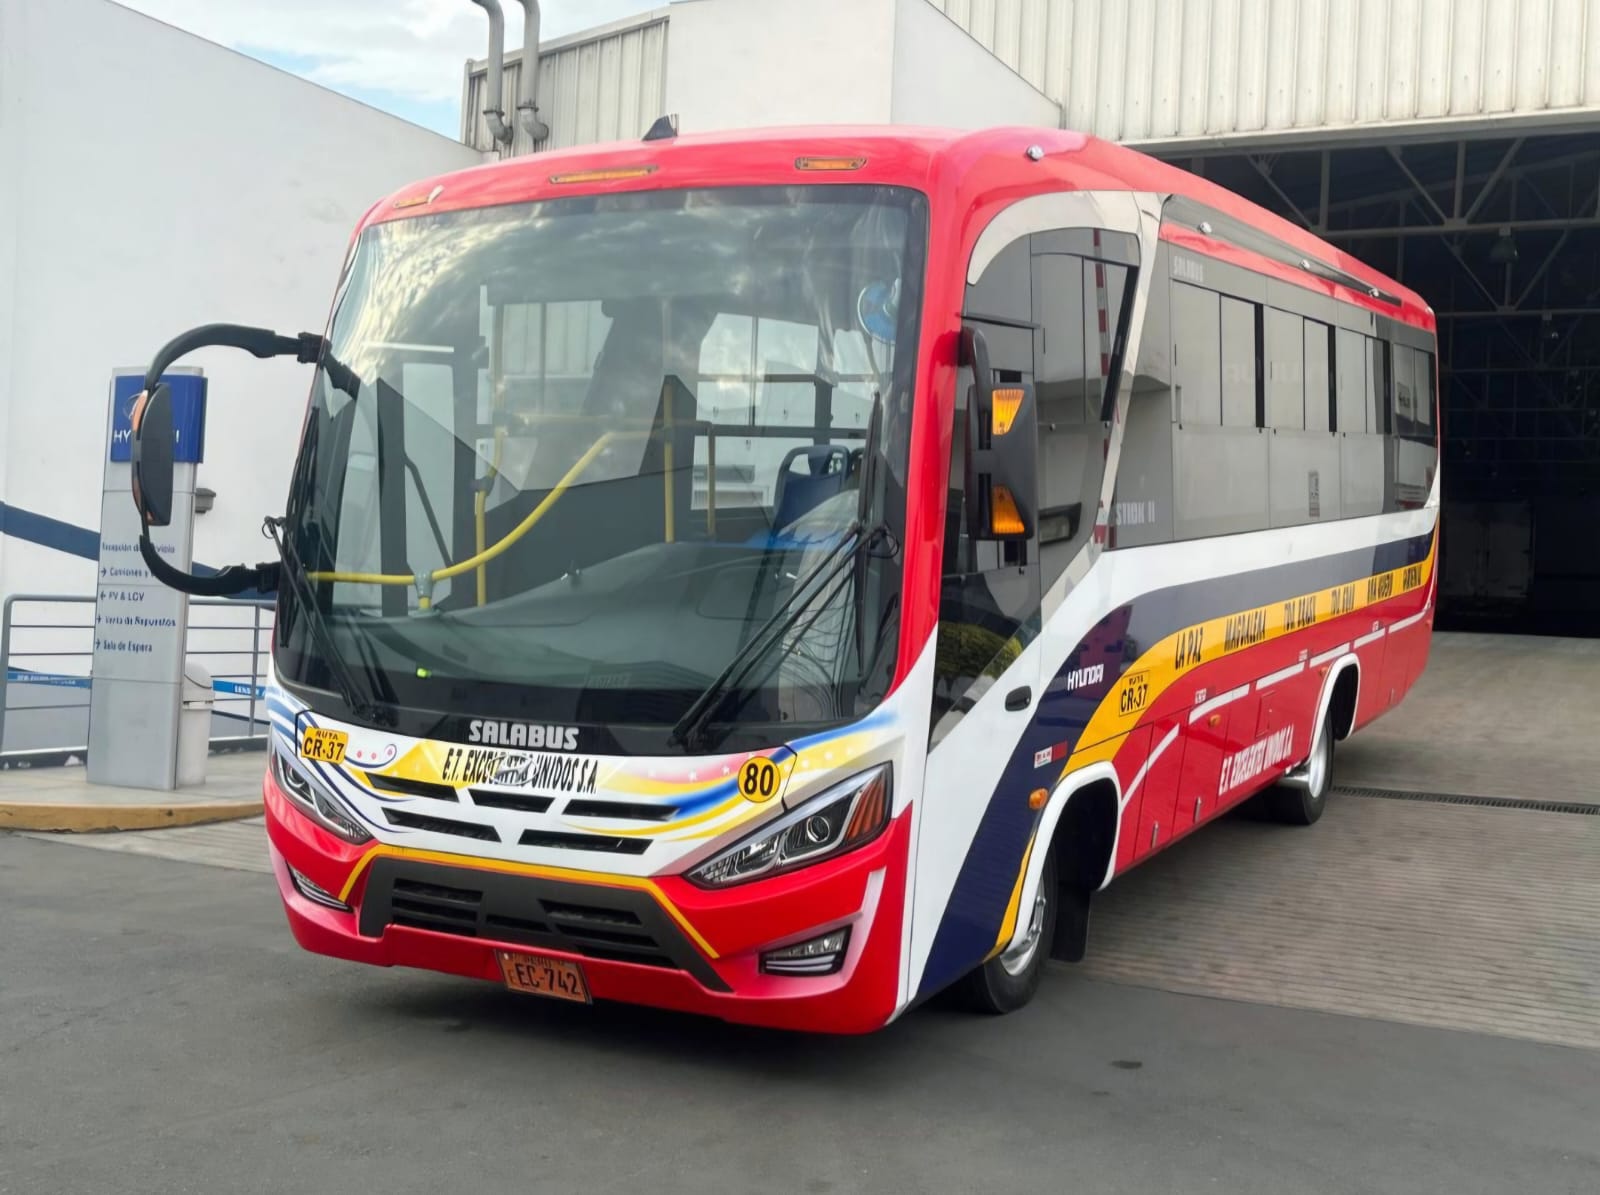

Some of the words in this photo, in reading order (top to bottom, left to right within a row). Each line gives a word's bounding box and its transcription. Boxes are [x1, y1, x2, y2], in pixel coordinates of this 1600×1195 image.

[128, 591, 146, 602] LCV
[134, 615, 177, 628] Repuestos
[127, 640, 153, 654] Espera
[1175, 631, 1186, 671] LA
[1187, 627, 1204, 667] PAZ
[1067, 663, 1105, 692] HYUNDAI
[315, 730, 339, 741] RUTA
[468, 719, 580, 751] SALABUS
[531, 753, 580, 792] UNIDOS
[743, 762, 775, 797] 80
